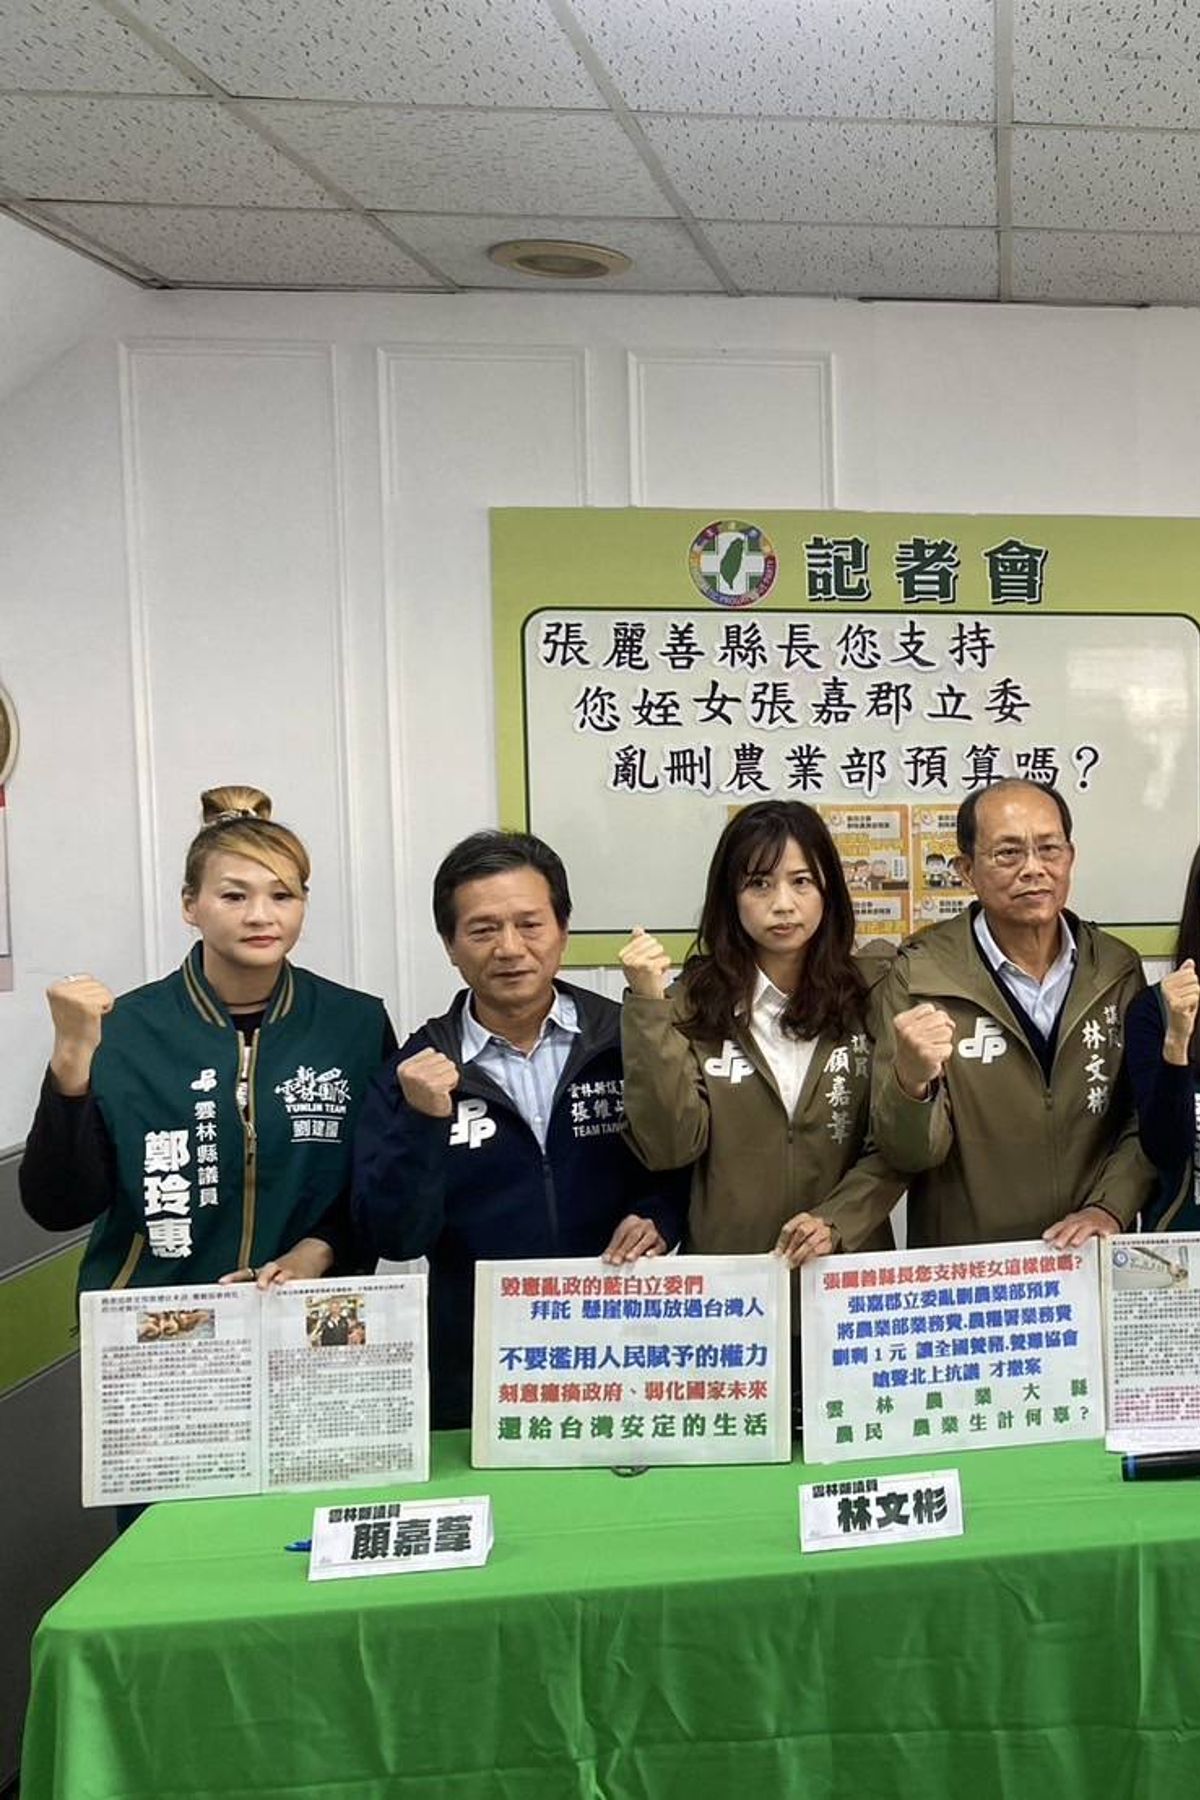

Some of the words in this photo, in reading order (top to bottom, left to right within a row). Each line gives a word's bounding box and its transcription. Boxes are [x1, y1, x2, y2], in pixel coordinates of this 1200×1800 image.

[804, 537, 1048, 602] 記者會
[542, 621, 996, 669] 張麗善縣長您支持
[576, 676, 1031, 731] 您姪女張嘉郡立委
[194, 1100, 219, 1208] 雲林縣議員
[501, 1275, 703, 1297] 毀憲亂政的藍白立委們
[531, 1300, 571, 1320] 拜託
[582, 1297, 765, 1320] 懸崖勒馬放過台灣人
[500, 1343, 768, 1371] 不要濫用人民賦予的權力
[889, 1343, 907, 1362] 元
[498, 1413, 768, 1440] 還給台灣安定的生活
[837, 1486, 948, 1533] 林文彬
